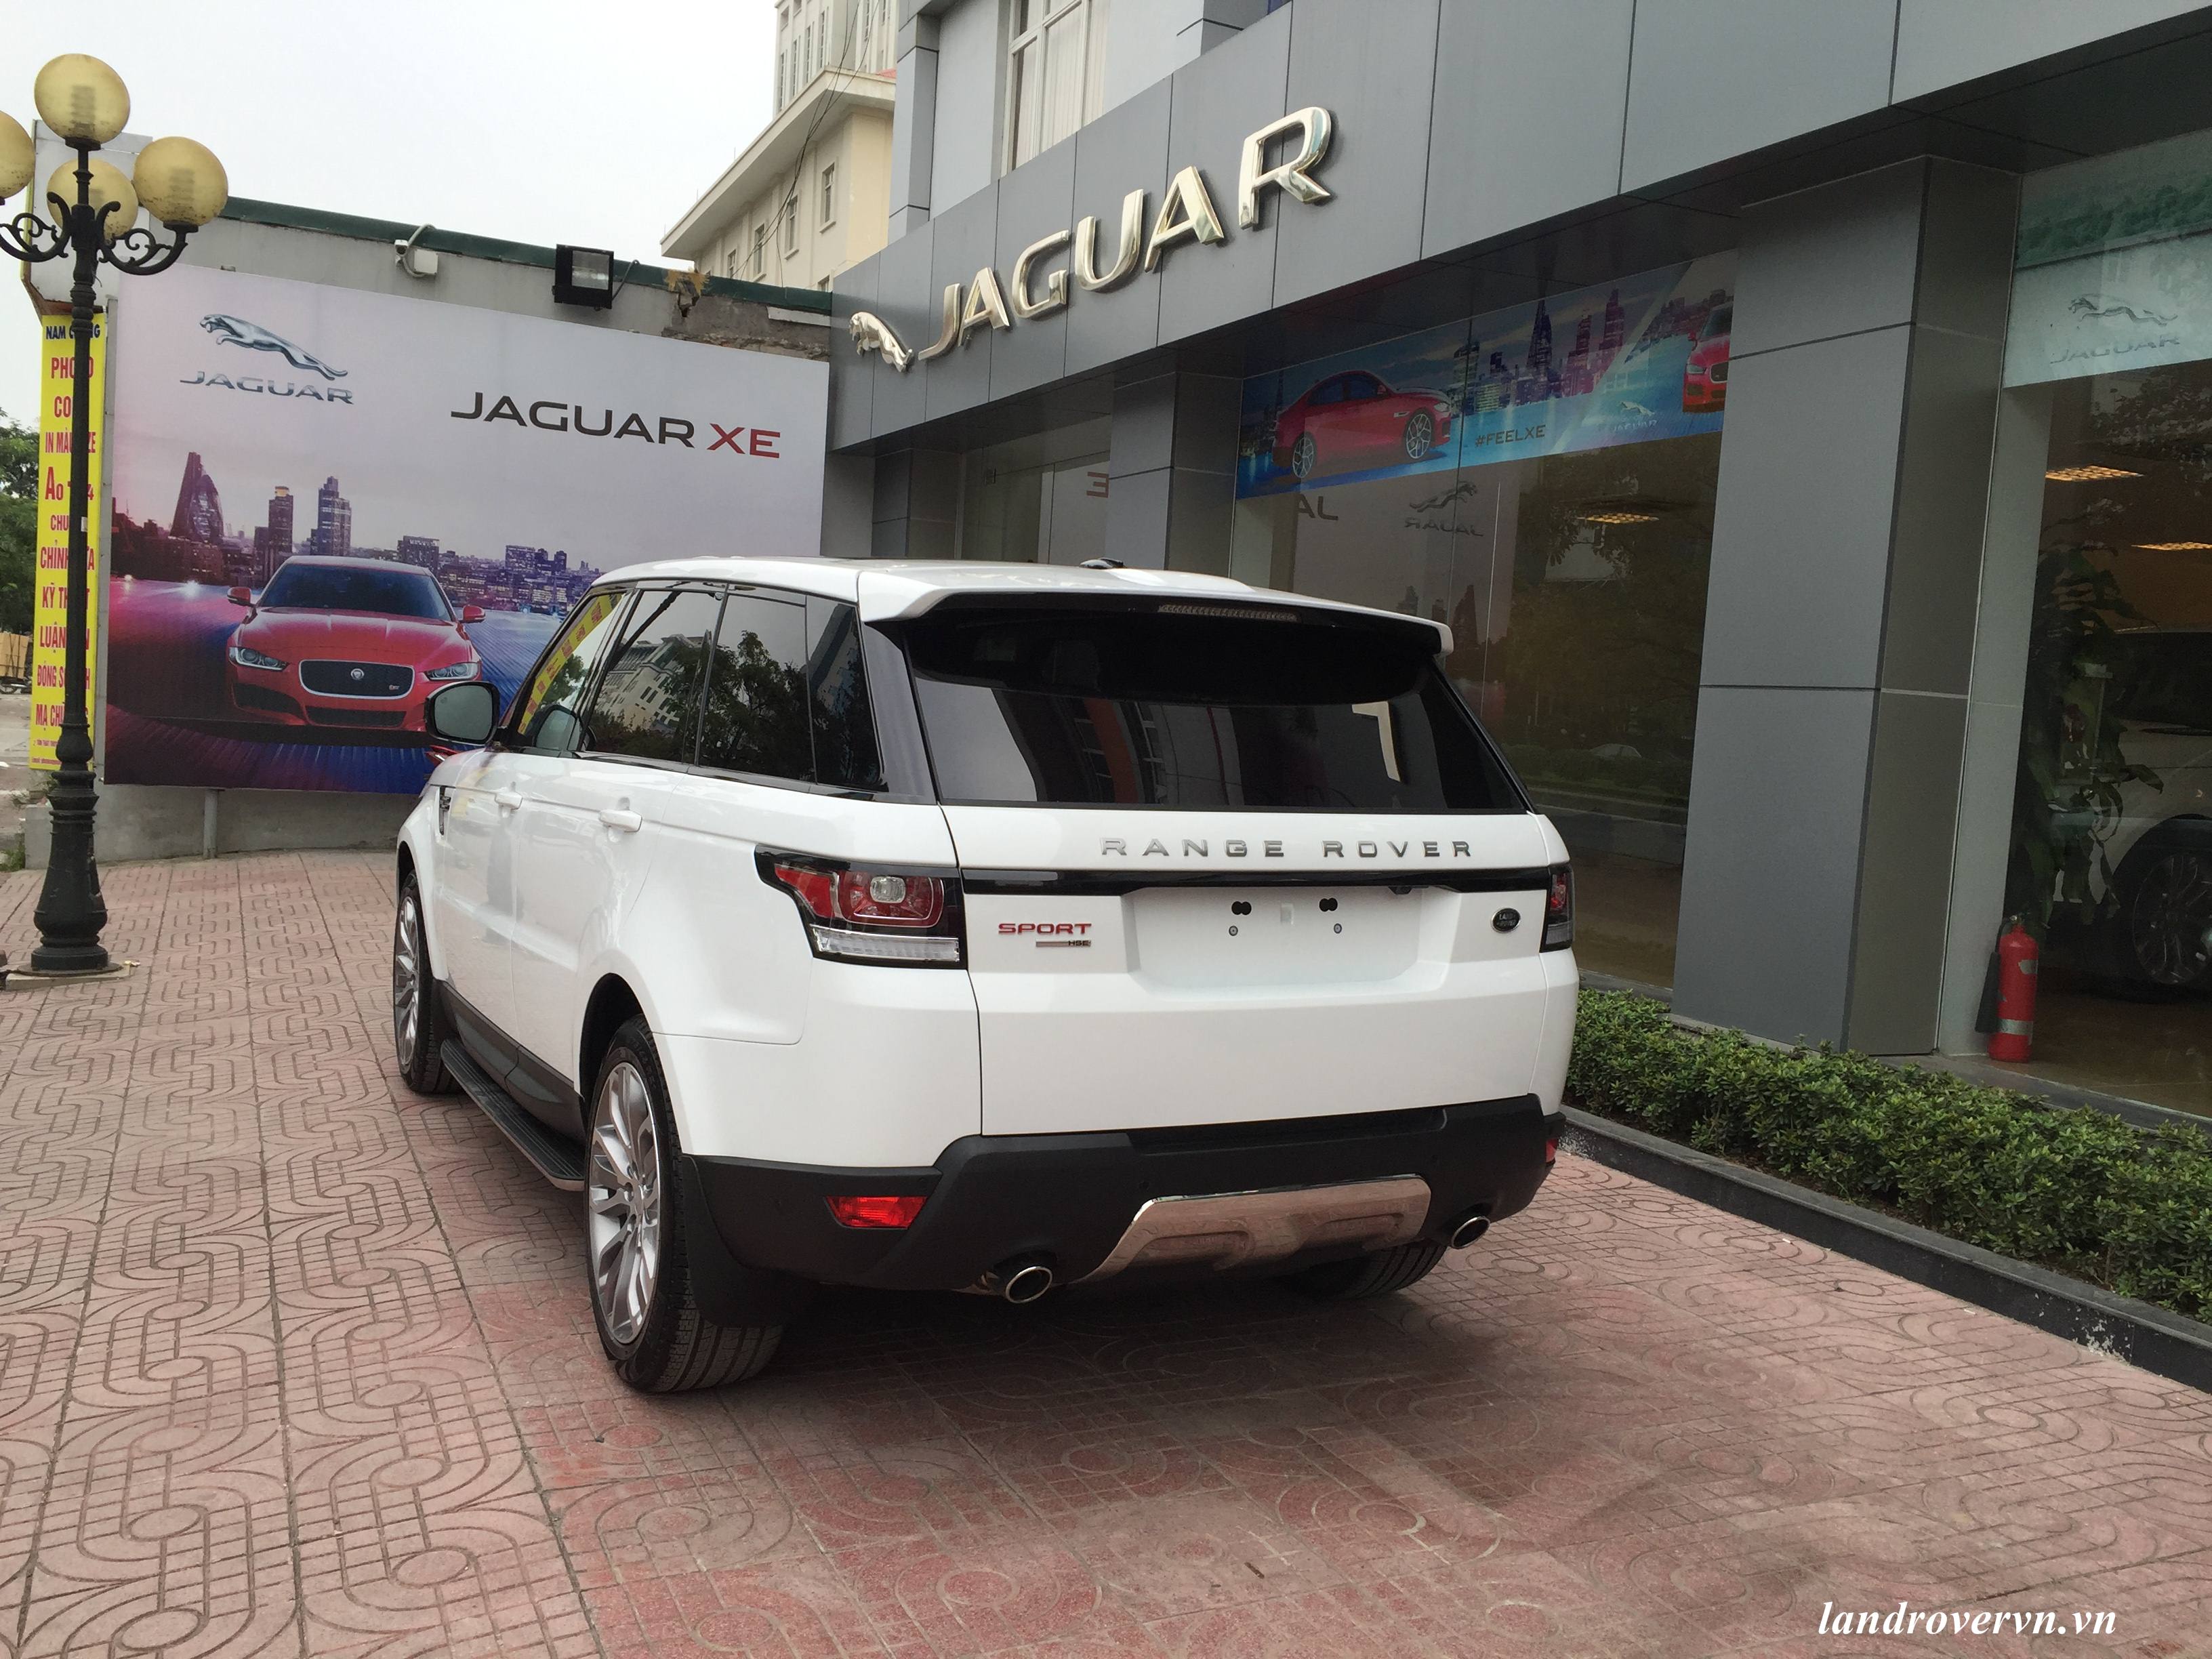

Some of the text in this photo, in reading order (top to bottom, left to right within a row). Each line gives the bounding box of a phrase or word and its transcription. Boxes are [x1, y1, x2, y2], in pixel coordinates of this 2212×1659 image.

[918, 106, 1331, 361] JAGUAR
[45, 325, 66, 339] NAM
[52, 357, 94, 379] PHOO
[180, 371, 354, 405] JAGUAR
[451, 392, 781, 458] JAGUAR XE
[1475, 424, 1545, 447] #FEELXE
[1100, 838, 1471, 858] RANGE ROVER
[998, 923, 1092, 934] SPORT
